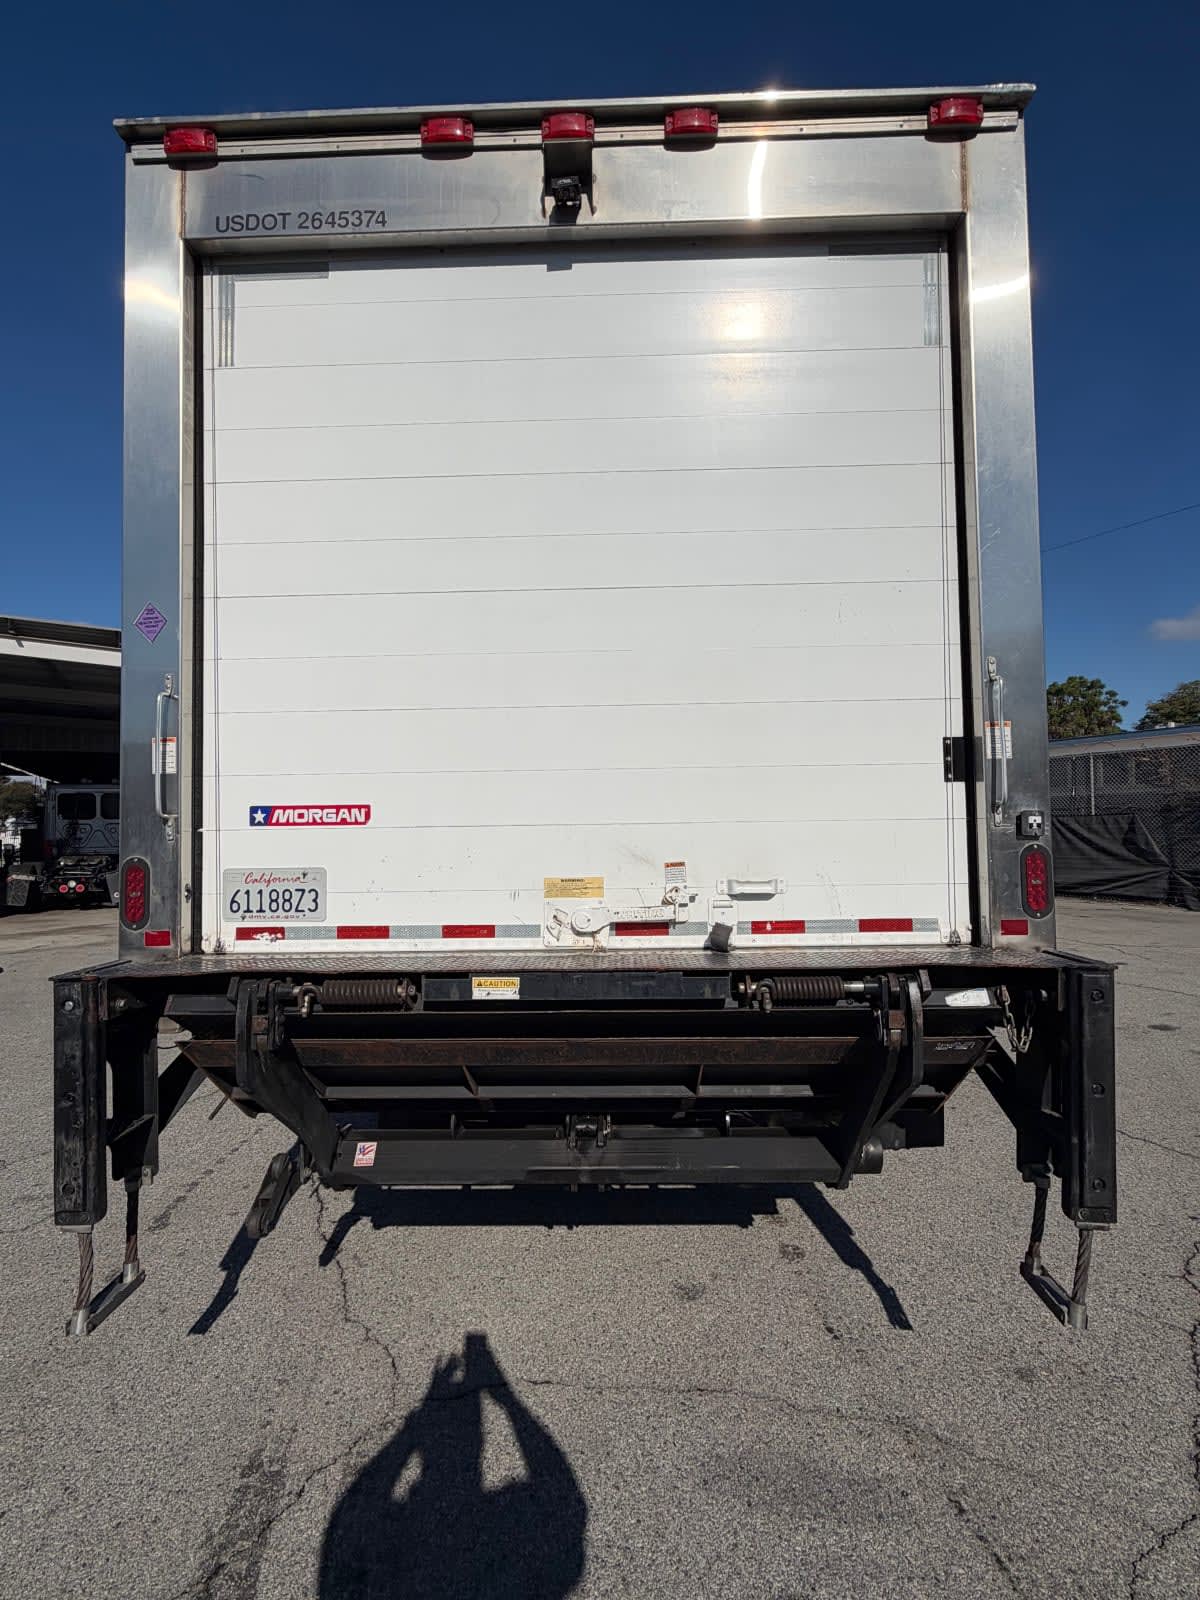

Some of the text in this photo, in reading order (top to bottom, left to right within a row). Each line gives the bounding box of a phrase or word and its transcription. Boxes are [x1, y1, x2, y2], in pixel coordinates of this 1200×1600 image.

[215, 209, 388, 233] USDOT 2645374
[271, 807, 366, 824] MORGAN
[244, 871, 308, 888] California
[229, 888, 319, 914] 61188Z3
